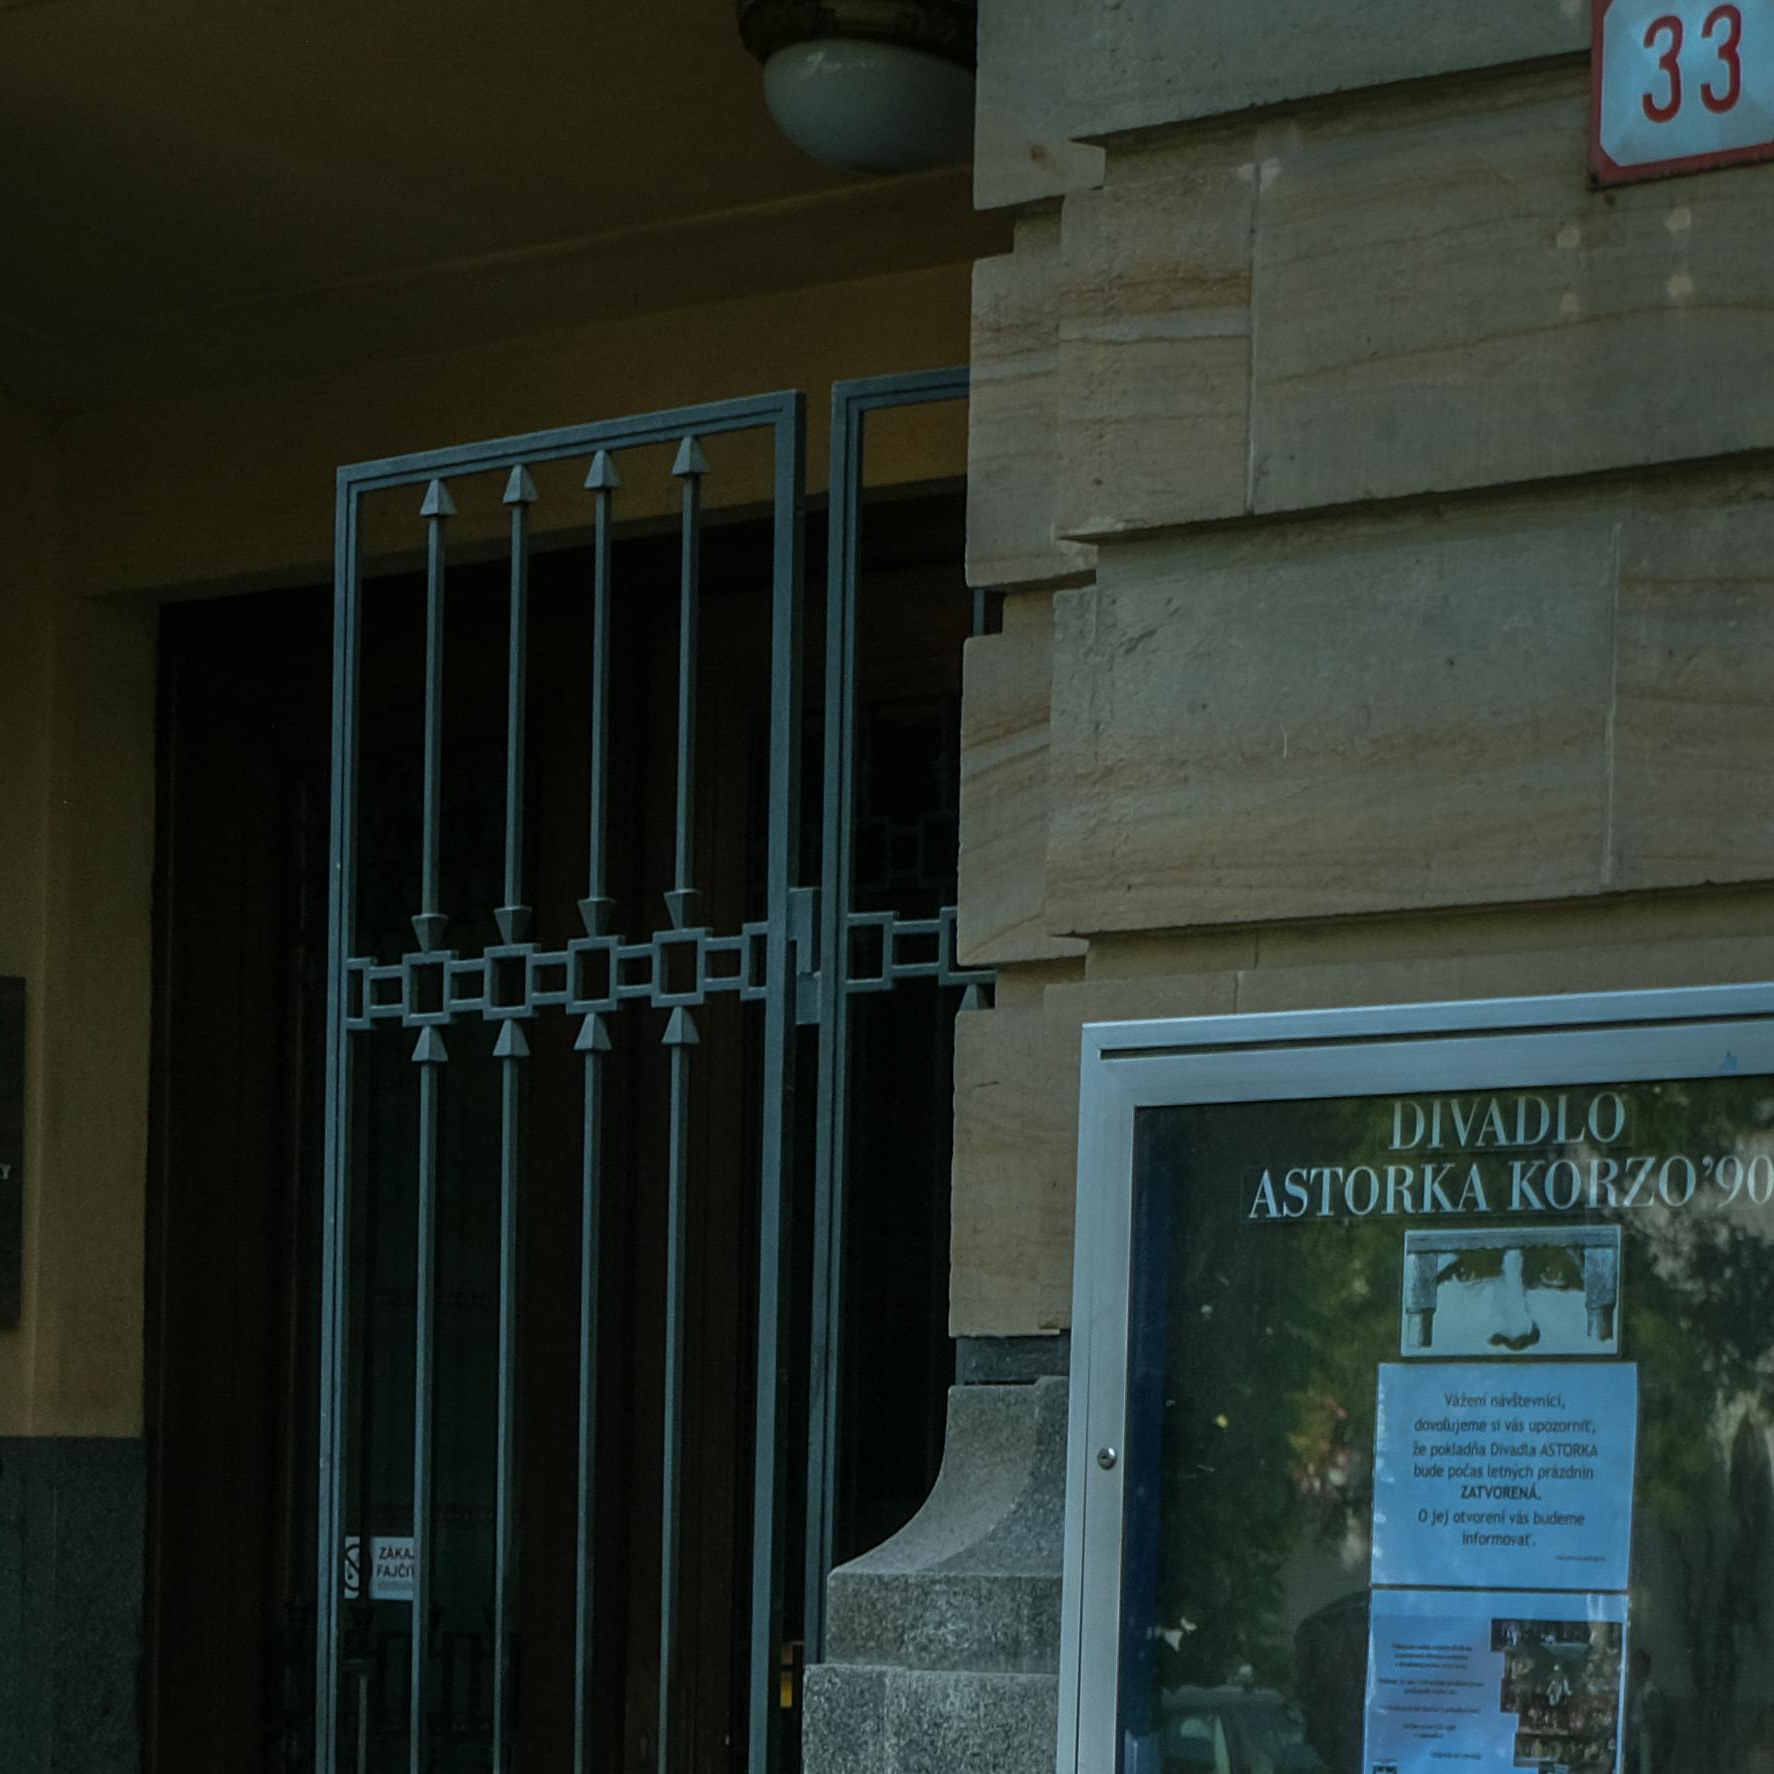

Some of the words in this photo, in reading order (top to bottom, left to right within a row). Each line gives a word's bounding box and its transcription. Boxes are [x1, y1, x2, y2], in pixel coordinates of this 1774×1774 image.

[1642, 4, 1742, 124] 33
[1388, 1092, 1627, 1151] DIVADLO
[1248, 1162, 1492, 1220] ASTORKA
[1505, 1419, 1525, 1433] vás
[1412, 1441, 1427, 1457] že
[1490, 1441, 1536, 1457] Divadla
[1539, 1442, 1598, 1458] ASTORKA
[1413, 1463, 1444, 1478] bude
[1447, 1462, 1483, 1481] počas
[1487, 1463, 1533, 1482] letných
[1537, 1463, 1594, 1481] prázdnin
[1460, 1483, 1543, 1501] ZATVORENÁ.
[1418, 1508, 1428, 1523] O
[1431, 1509, 1449, 1527] jej
[1452, 1509, 1506, 1525] otvorení
[1509, 1509, 1529, 1525] vás
[1533, 1510, 1586, 1527] budeme
